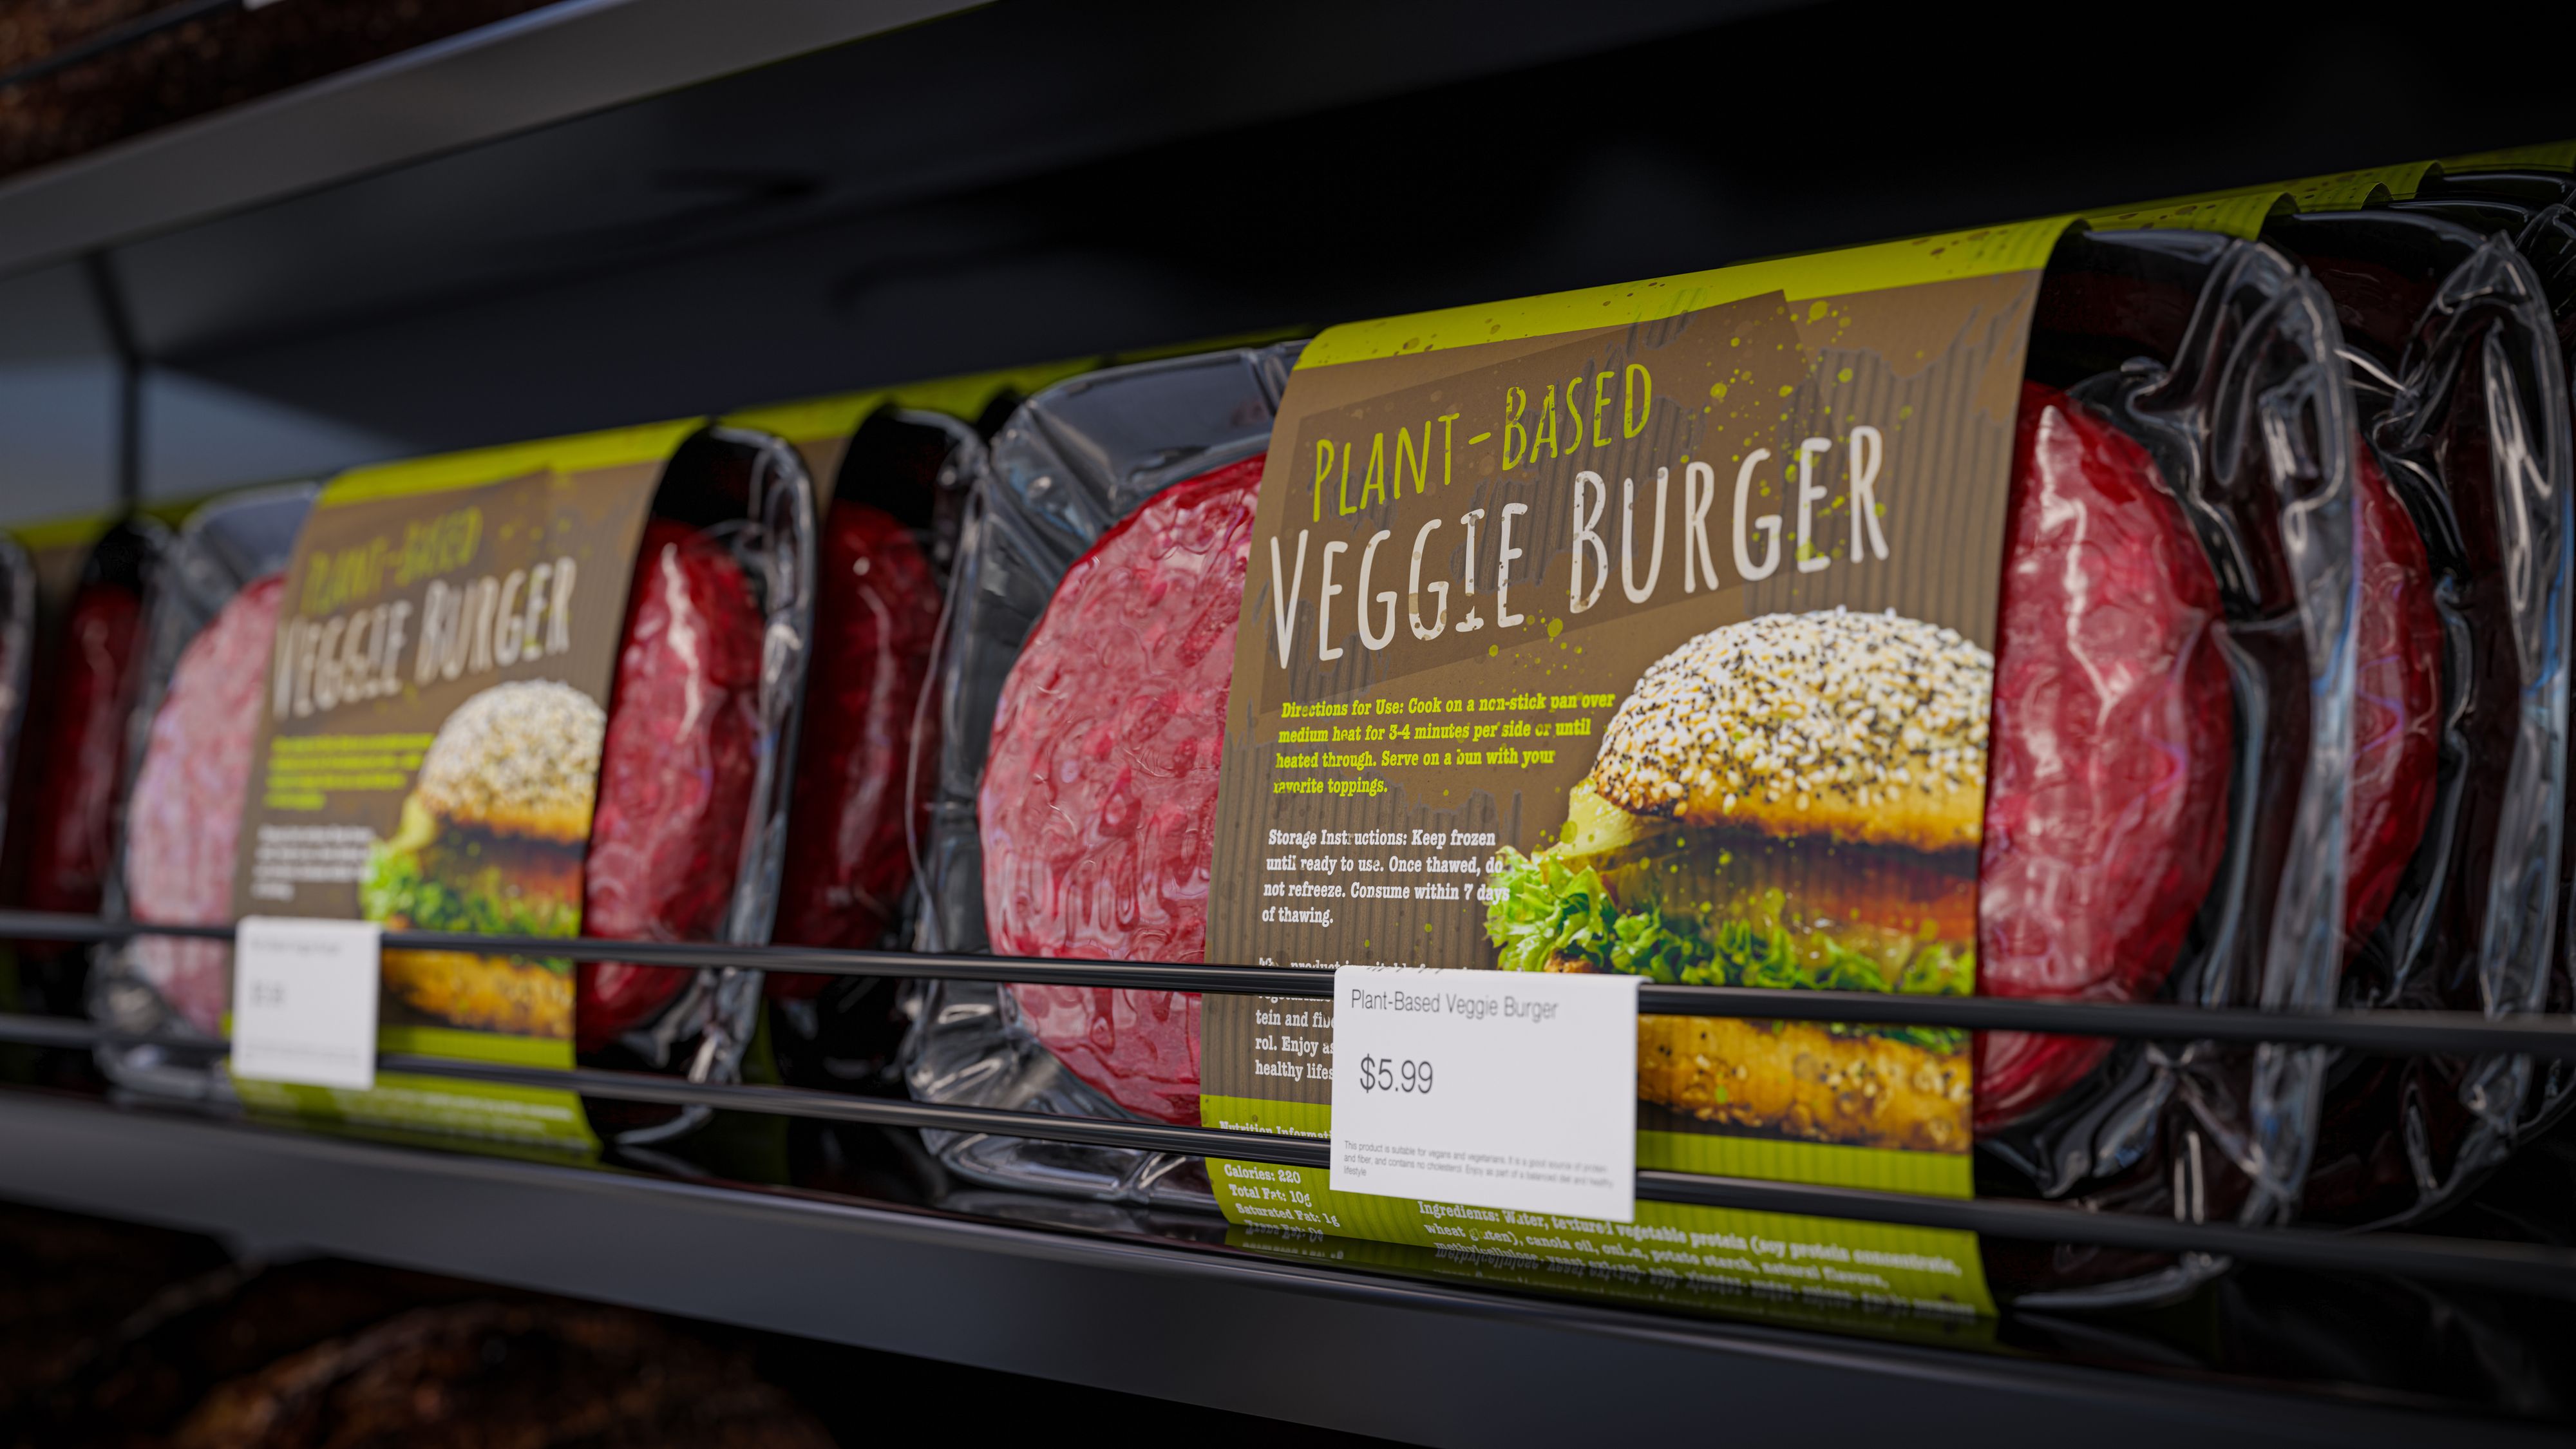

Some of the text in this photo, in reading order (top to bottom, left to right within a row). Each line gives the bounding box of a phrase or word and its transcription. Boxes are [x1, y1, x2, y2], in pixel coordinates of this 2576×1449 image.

[1313, 363, 1652, 522] PLANT-BASED
[1269, 424, 1889, 670] VEGGIE BURGER
[1281, 701, 1348, 717] Directions
[1351, 700, 1372, 715] for
[1376, 699, 1404, 715] Use:
[1408, 697, 1442, 714] Cook
[1446, 699, 1463, 712] on
[1466, 699, 1475, 712] a
[1550, 694, 1577, 713] pan
[1581, 694, 1616, 708] over
[1278, 717, 1591, 743] medium heat for 3-4 minutes per side or until
[1275, 747, 1556, 771] heated through. Serve on a bun with your
[1327, 777, 1388, 797] toppings.
[1268, 829, 1317, 849] Storage
[1412, 829, 1446, 849] Keep
[1450, 829, 1496, 846] frozen
[1266, 854, 1503, 877] until ready to use. Once thawed, do
[1264, 881, 1510, 905] not refreeze. Consume within 7 days
[1262, 906, 1333, 927] of thawing.
[1352, 989, 1558, 1023] Plant-Based Veggie Burger
[1256, 1009, 1281, 1026] tein
[1285, 1012, 1308, 1027] and
[1255, 1035, 1277, 1051] rol.
[1282, 1036, 1318, 1057] Enjoy
[1255, 1059, 1303, 1082] healthy
[1360, 1054, 1432, 1094] $5.99
[1344, 1153, 1356, 1163] and
[1358, 1154, 1373, 1165] fiber,
[1375, 1157, 1387, 1166] and
[1388, 1158, 1414, 1169] contains
[1417, 1160, 1425, 1170] no
[1345, 1141, 1357, 1150] This
[1359, 1142, 1383, 1153] product
[1385, 1144, 1390, 1153] is
[1392, 1145, 1416, 1155] suitable
[1417, 1147, 1426, 1157] for
[1428, 1149, 1451, 1160] vegans
[1454, 1151, 1466, 1160] and
[1224, 1164, 1301, 1184] Calories: 220
[1344, 1166, 1367, 1177] lifestyle
[1228, 1184, 1312, 1208] Total Fat: 10g
[1235, 1203, 1340, 1227] Saturated Fat: 1g
[1417, 1200, 1500, 1222] Ingredients:
[1615, 1224, 1687, 1244] vegetable
[1424, 1223, 1466, 1238] wheat
[1525, 1235, 1573, 1250] canola
[1574, 1238, 1600, 1255] oil,
